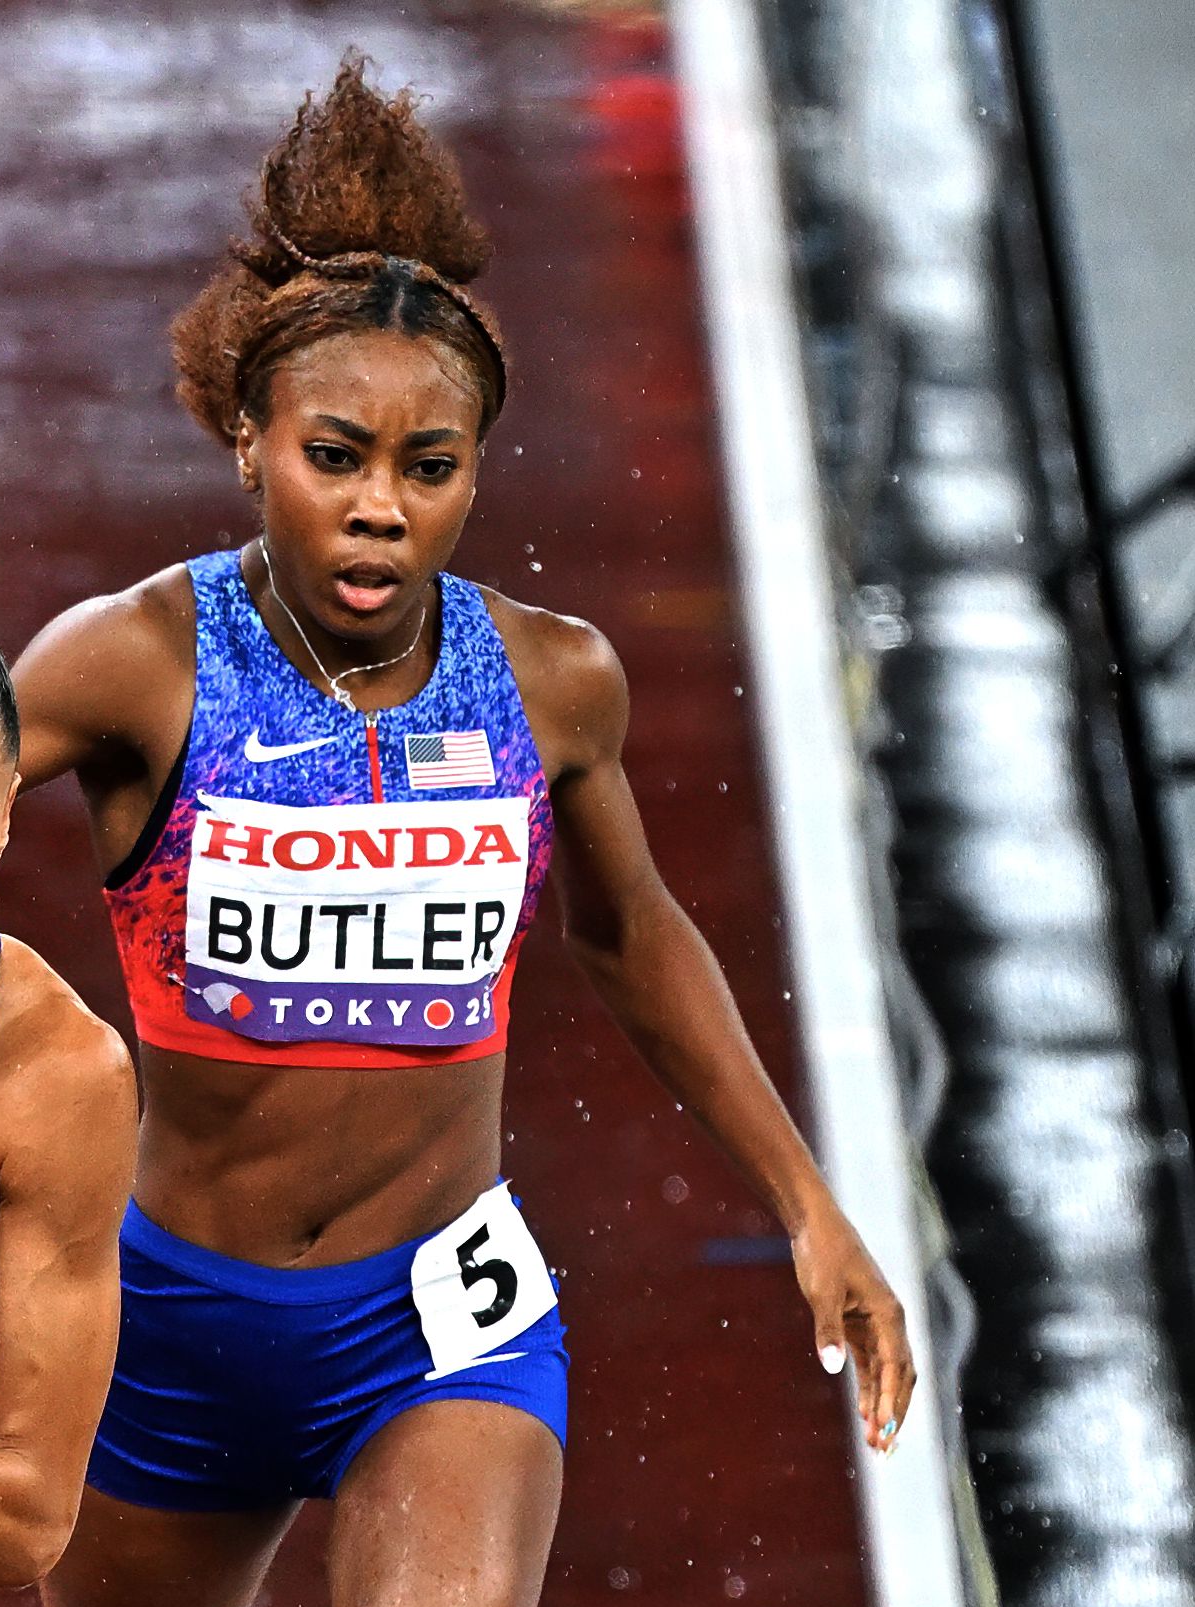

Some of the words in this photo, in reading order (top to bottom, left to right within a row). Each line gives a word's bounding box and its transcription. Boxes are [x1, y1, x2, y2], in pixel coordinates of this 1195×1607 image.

[200, 819, 521, 871] HONDA
[207, 896, 505, 970] BUTLER
[464, 991, 491, 1027] 25
[456, 1222, 518, 1328] 5
